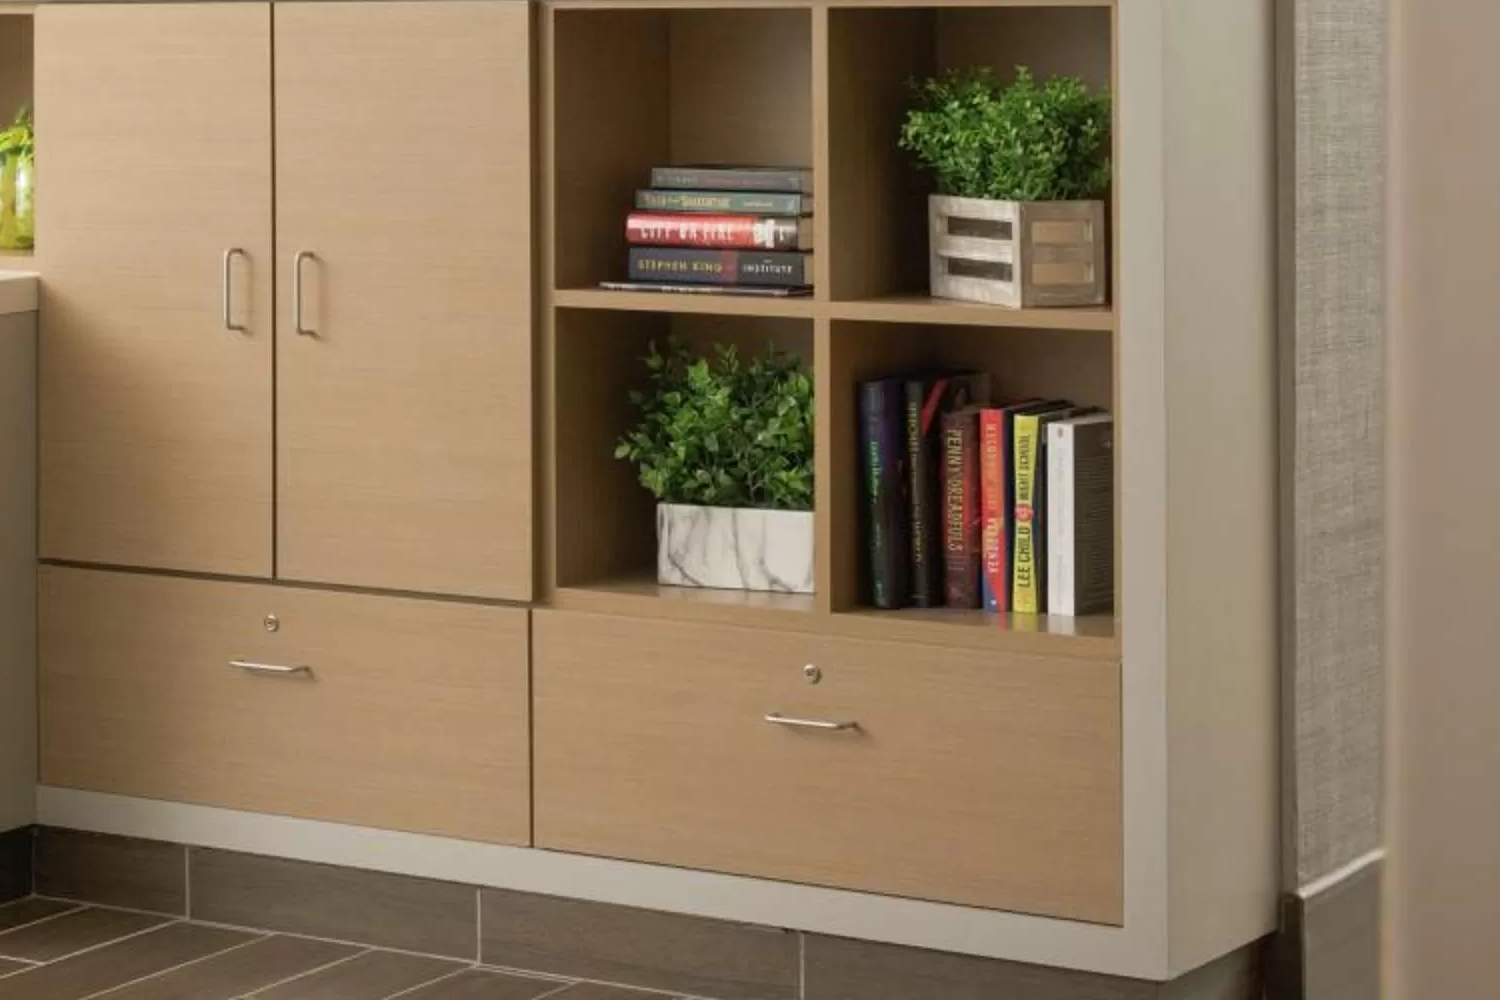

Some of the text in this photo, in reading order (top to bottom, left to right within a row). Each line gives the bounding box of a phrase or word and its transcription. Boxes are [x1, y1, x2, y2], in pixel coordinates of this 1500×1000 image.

[637, 259, 723, 274] STEPHEN KING
[742, 263, 793, 274] INSTITUTE
[947, 428, 964, 551] PENNY DREADFULS
[1017, 527, 1031, 563] CHILD
[1017, 566, 1031, 588] LEE
